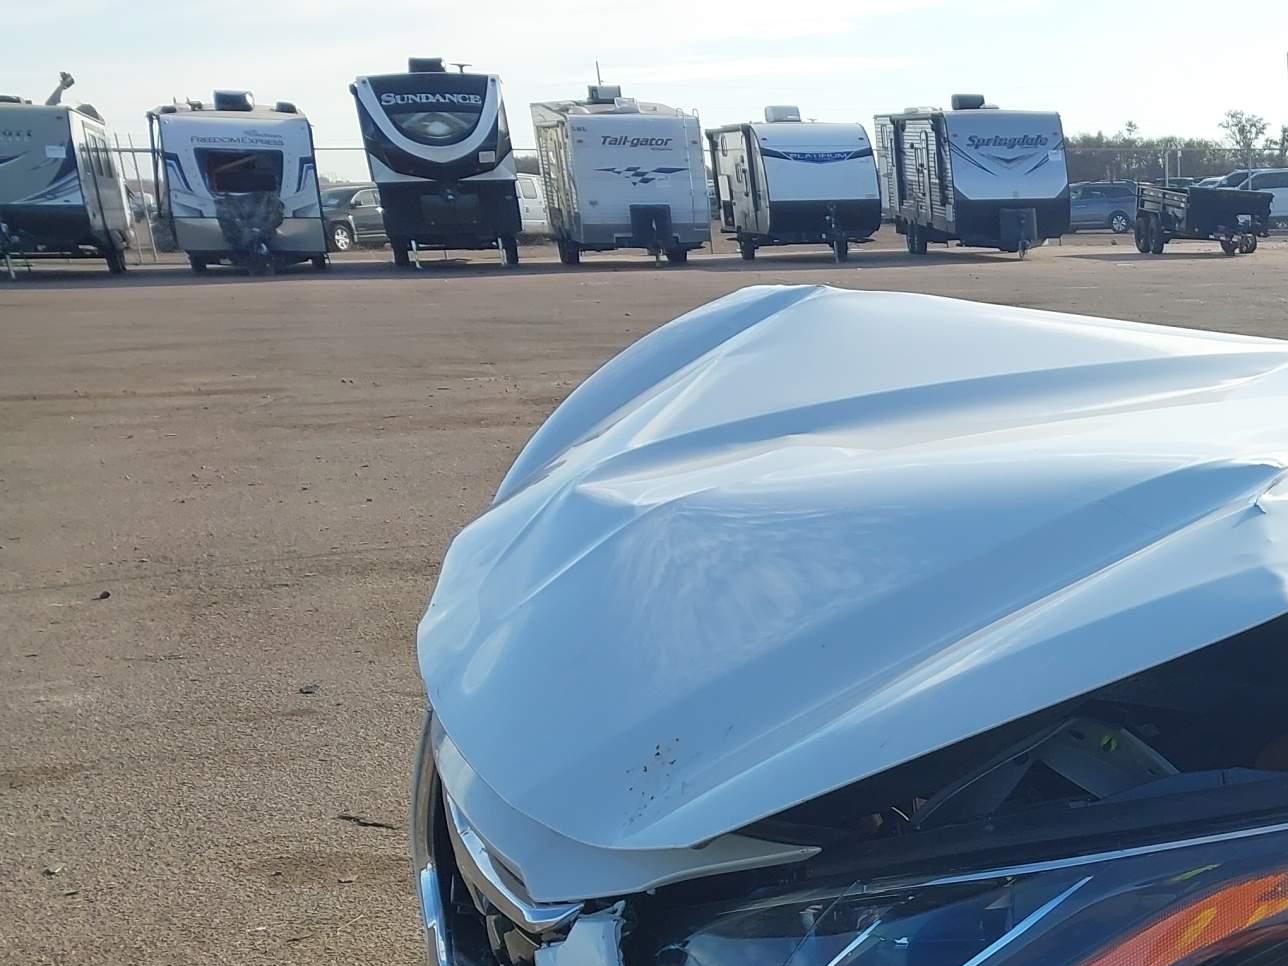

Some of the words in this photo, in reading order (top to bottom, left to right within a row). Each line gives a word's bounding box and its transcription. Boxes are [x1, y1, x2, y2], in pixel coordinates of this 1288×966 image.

[381, 93, 482, 105] SUNDANCE
[601, 136, 673, 148] Tail-gator
[966, 134, 1049, 150] Springdale
